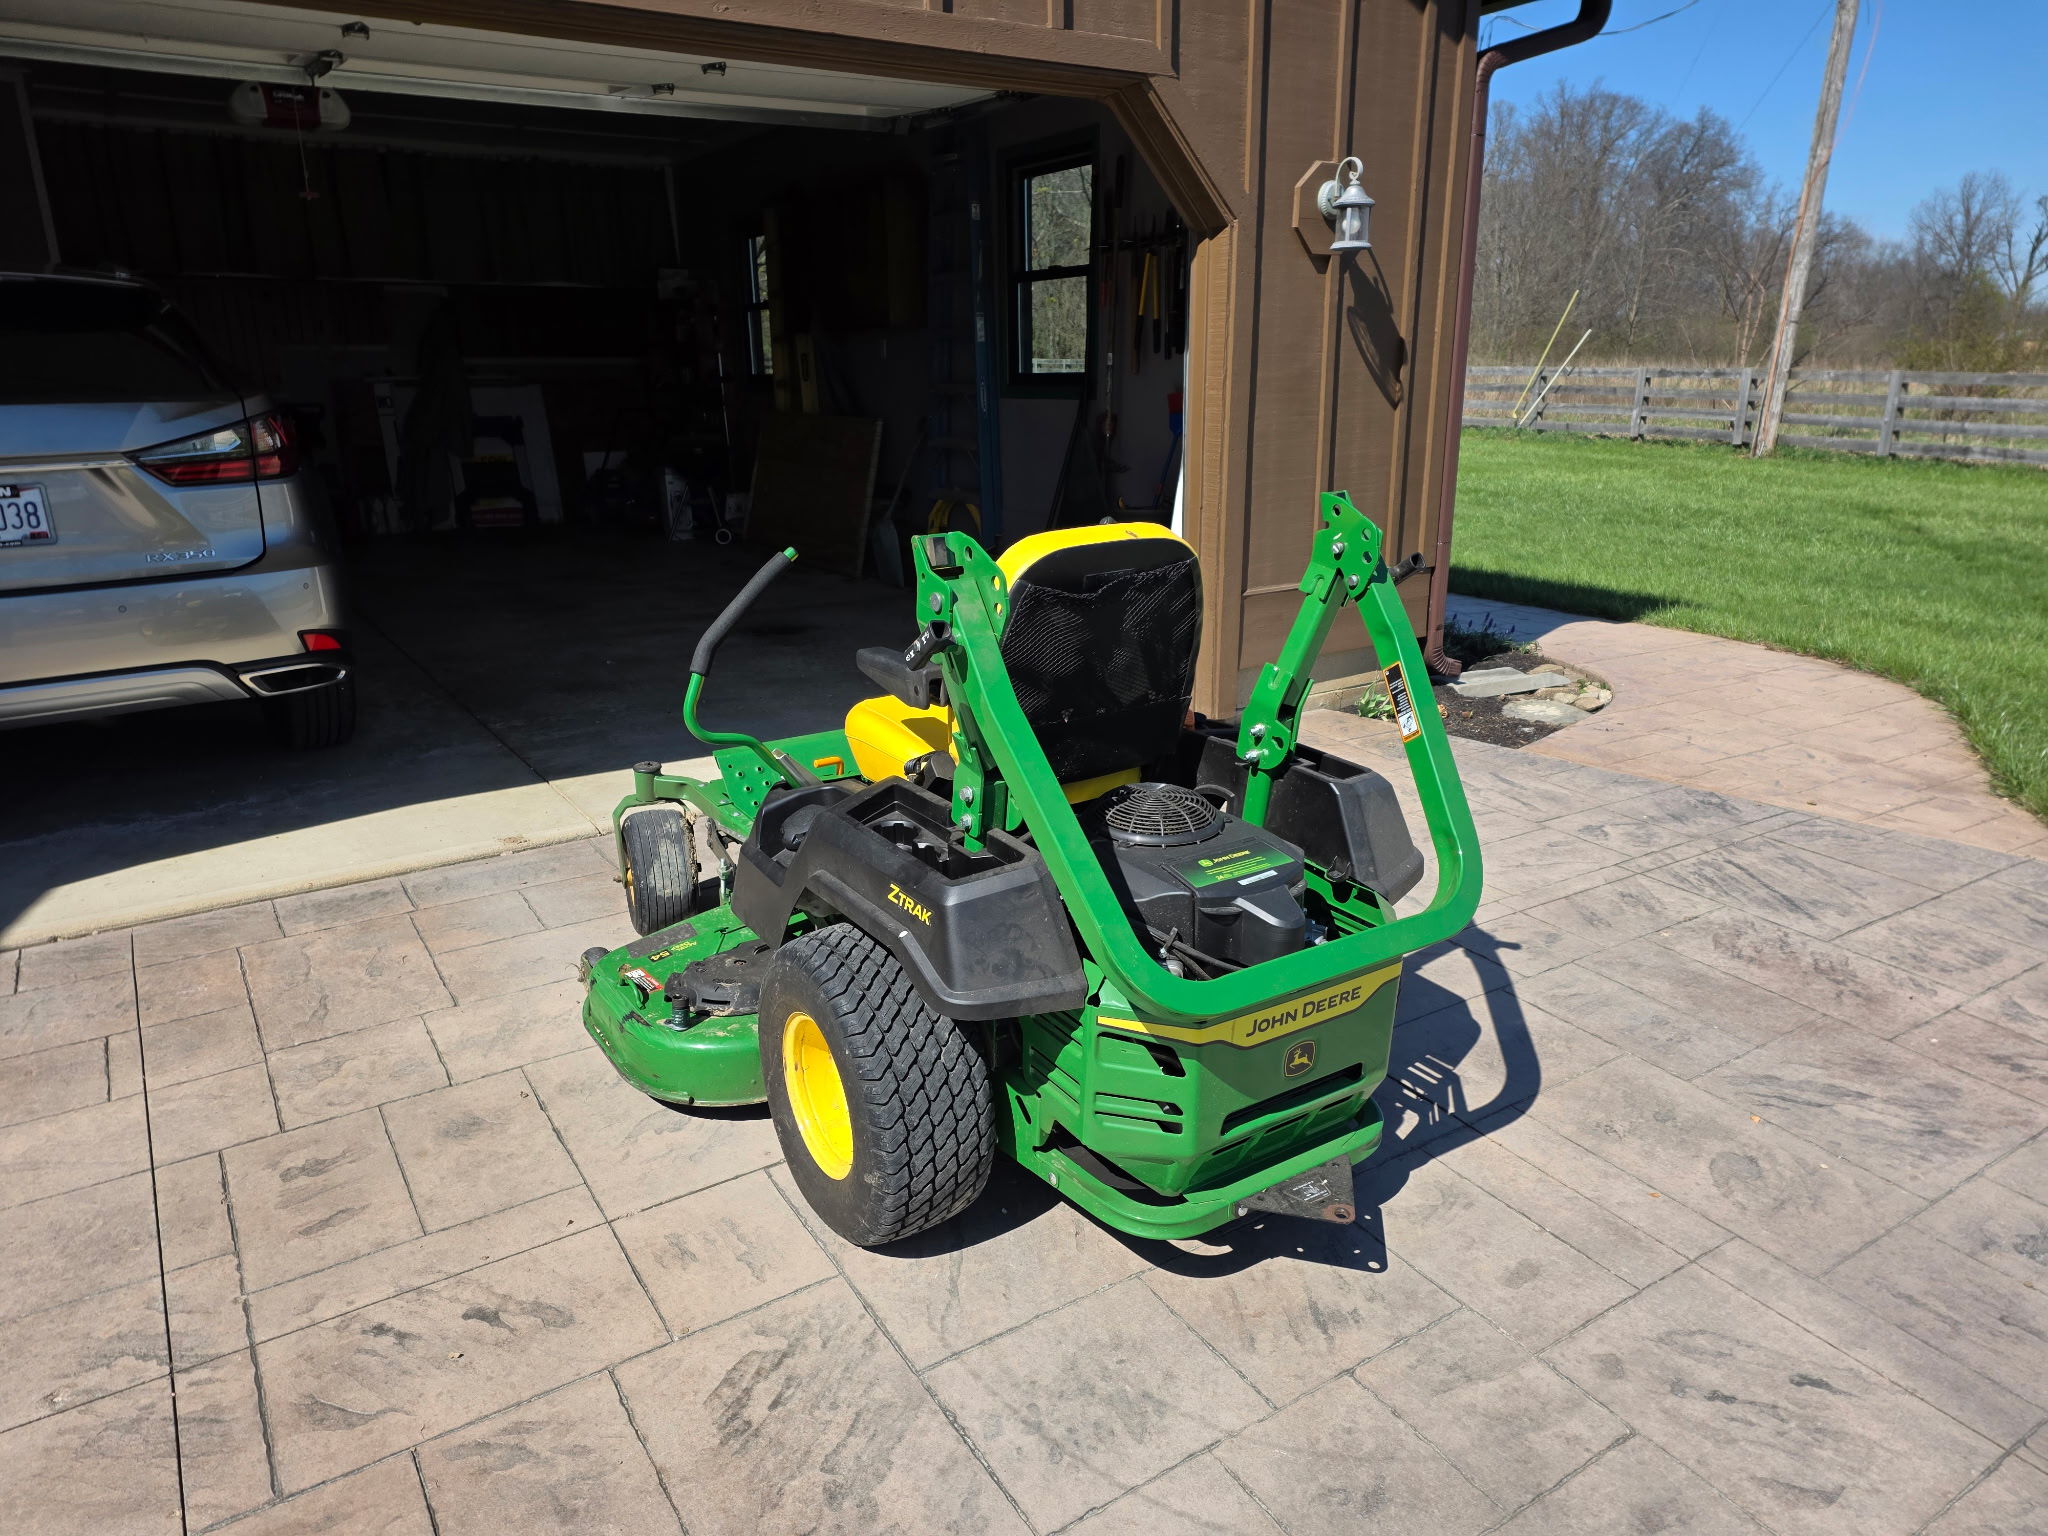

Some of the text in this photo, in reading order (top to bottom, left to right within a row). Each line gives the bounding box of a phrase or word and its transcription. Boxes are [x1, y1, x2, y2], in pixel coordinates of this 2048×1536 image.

[887, 883, 932, 926] ZTRAK
[650, 950, 670, 961] 54
[1245, 985, 1363, 1038] JOHN DEERE
